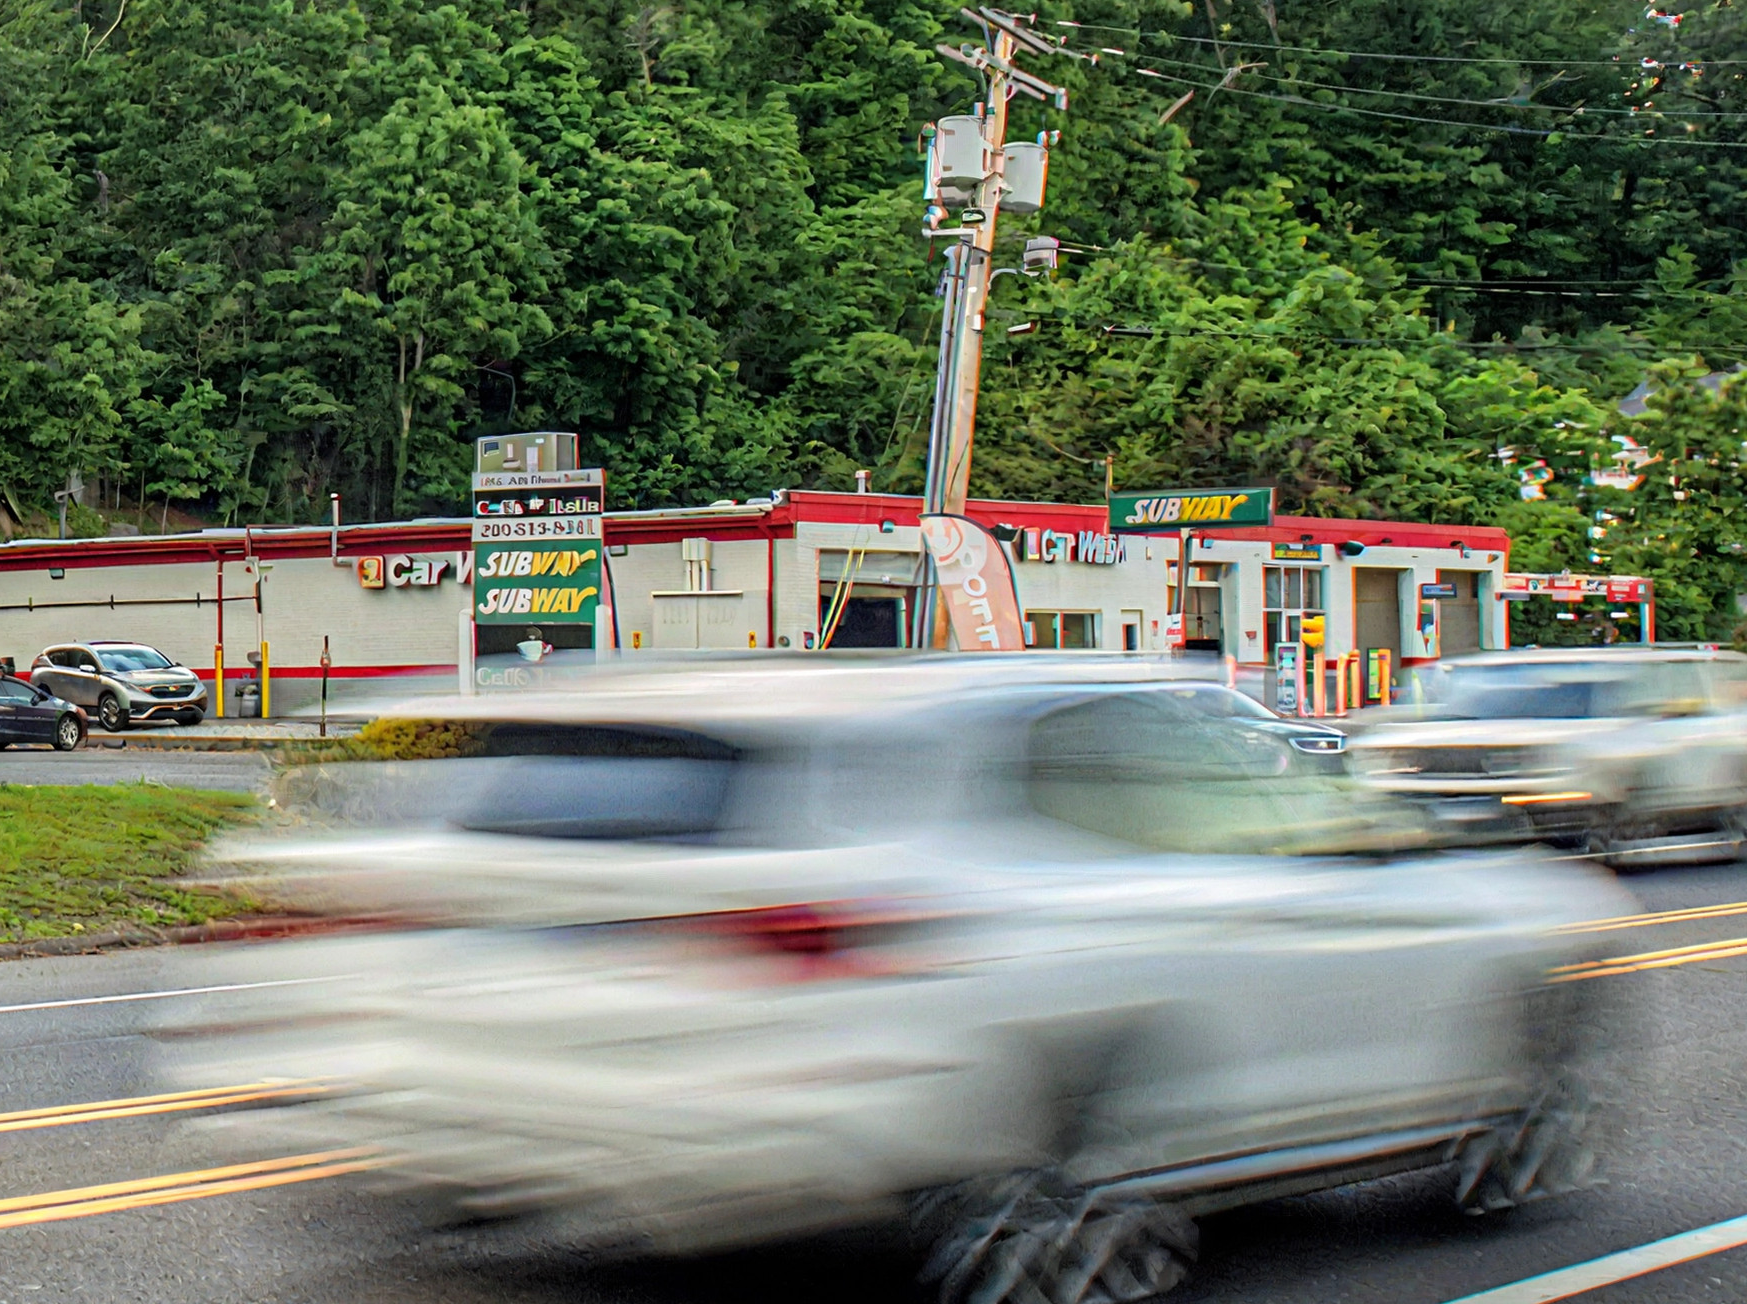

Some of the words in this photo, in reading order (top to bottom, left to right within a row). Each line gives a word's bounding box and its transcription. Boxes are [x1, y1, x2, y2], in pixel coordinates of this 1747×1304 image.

[1125, 494, 1249, 524] SUBWAY
[388, 553, 449, 587] Car
[478, 549, 597, 578] SUBWAY
[478, 586, 598, 614] SUBWAY
